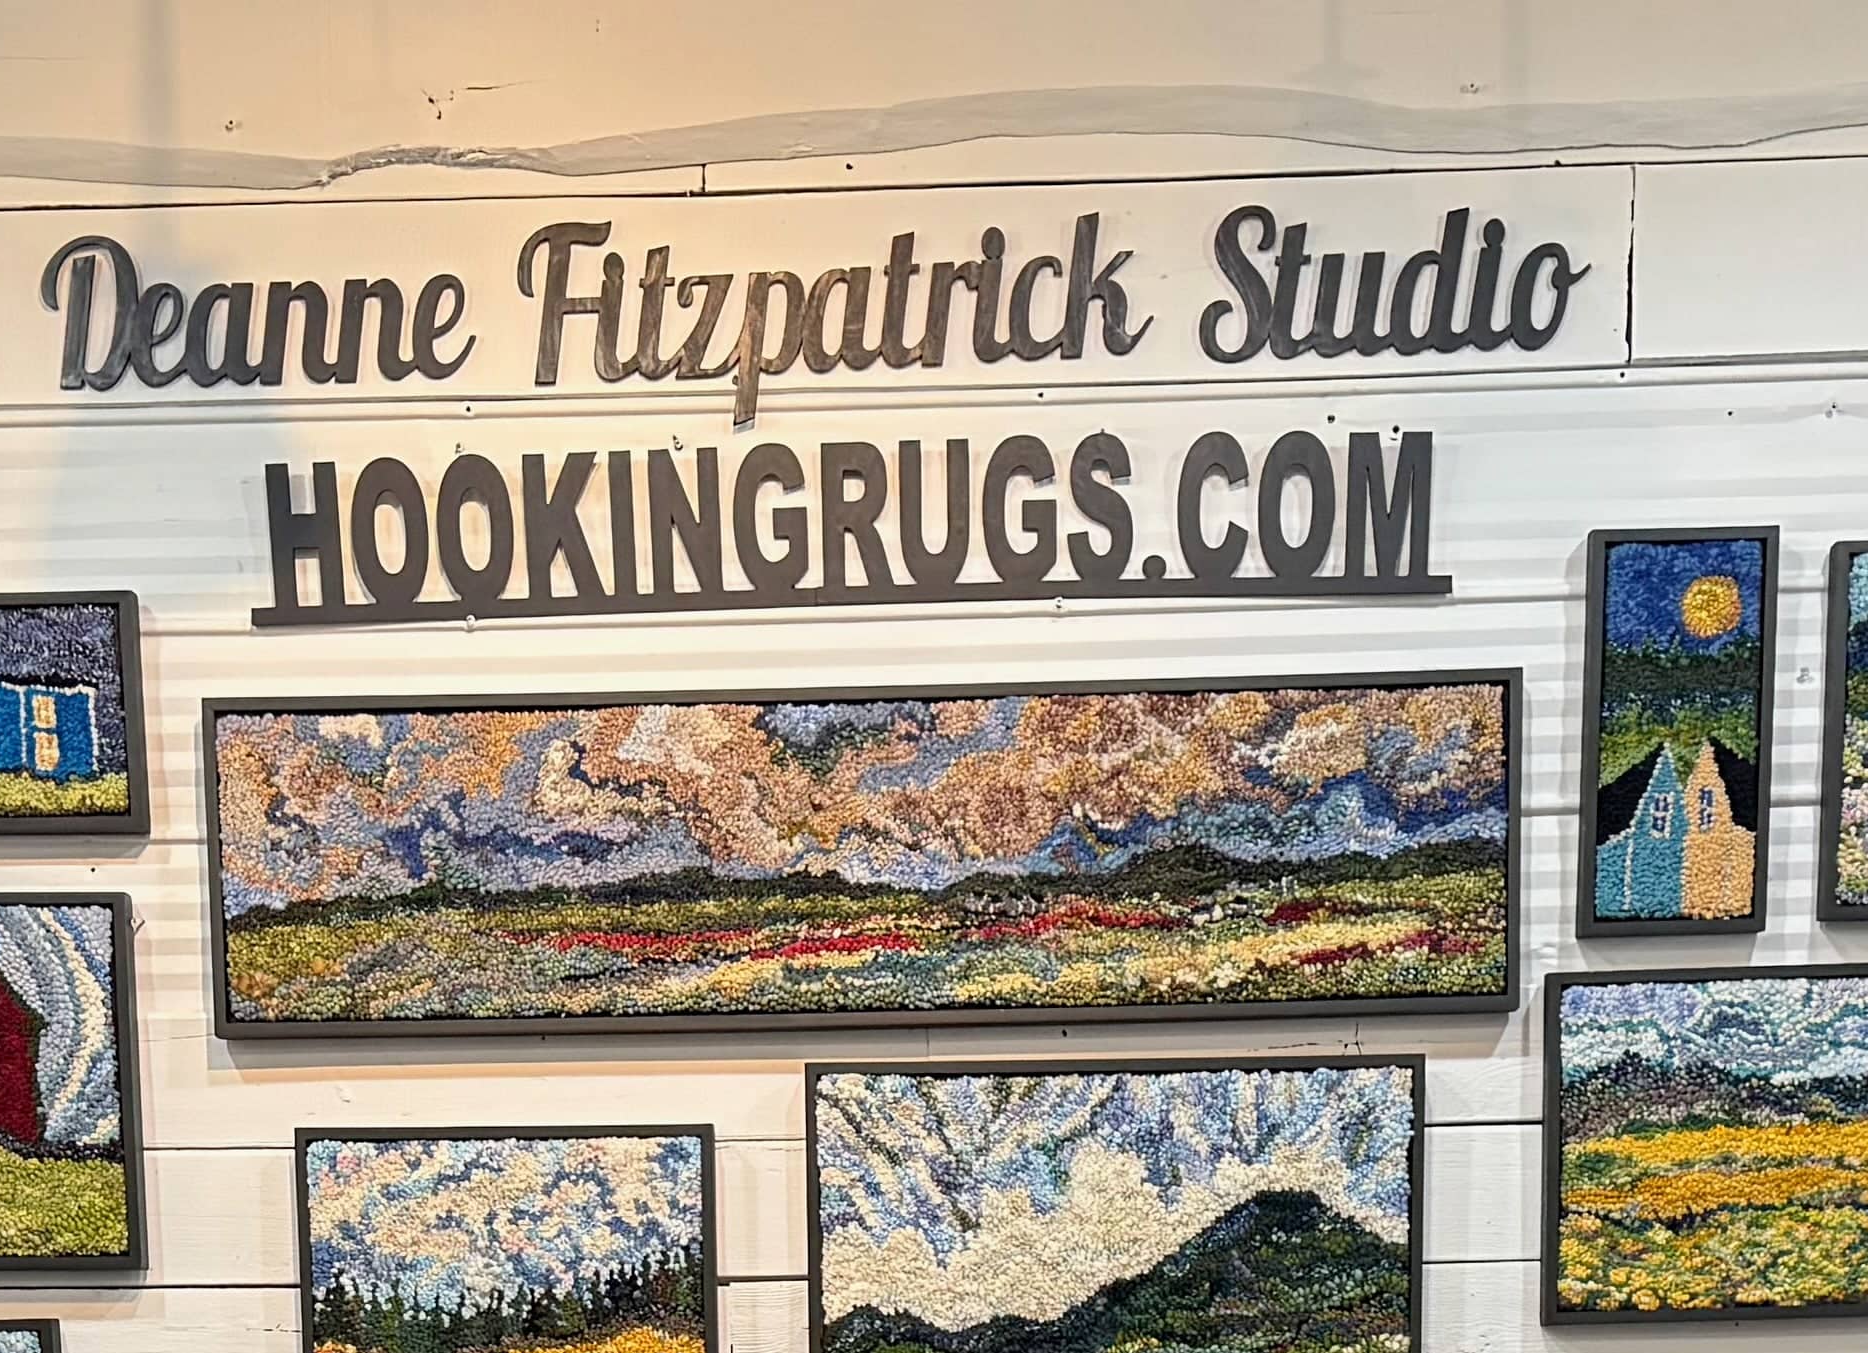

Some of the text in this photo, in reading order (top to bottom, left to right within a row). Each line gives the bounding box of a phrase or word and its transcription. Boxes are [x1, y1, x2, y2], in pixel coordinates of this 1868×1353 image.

[38, 204, 1592, 432] Deanne Fitzpatrick Studio
[262, 428, 1436, 612] HOOKINGRUGS.COM
